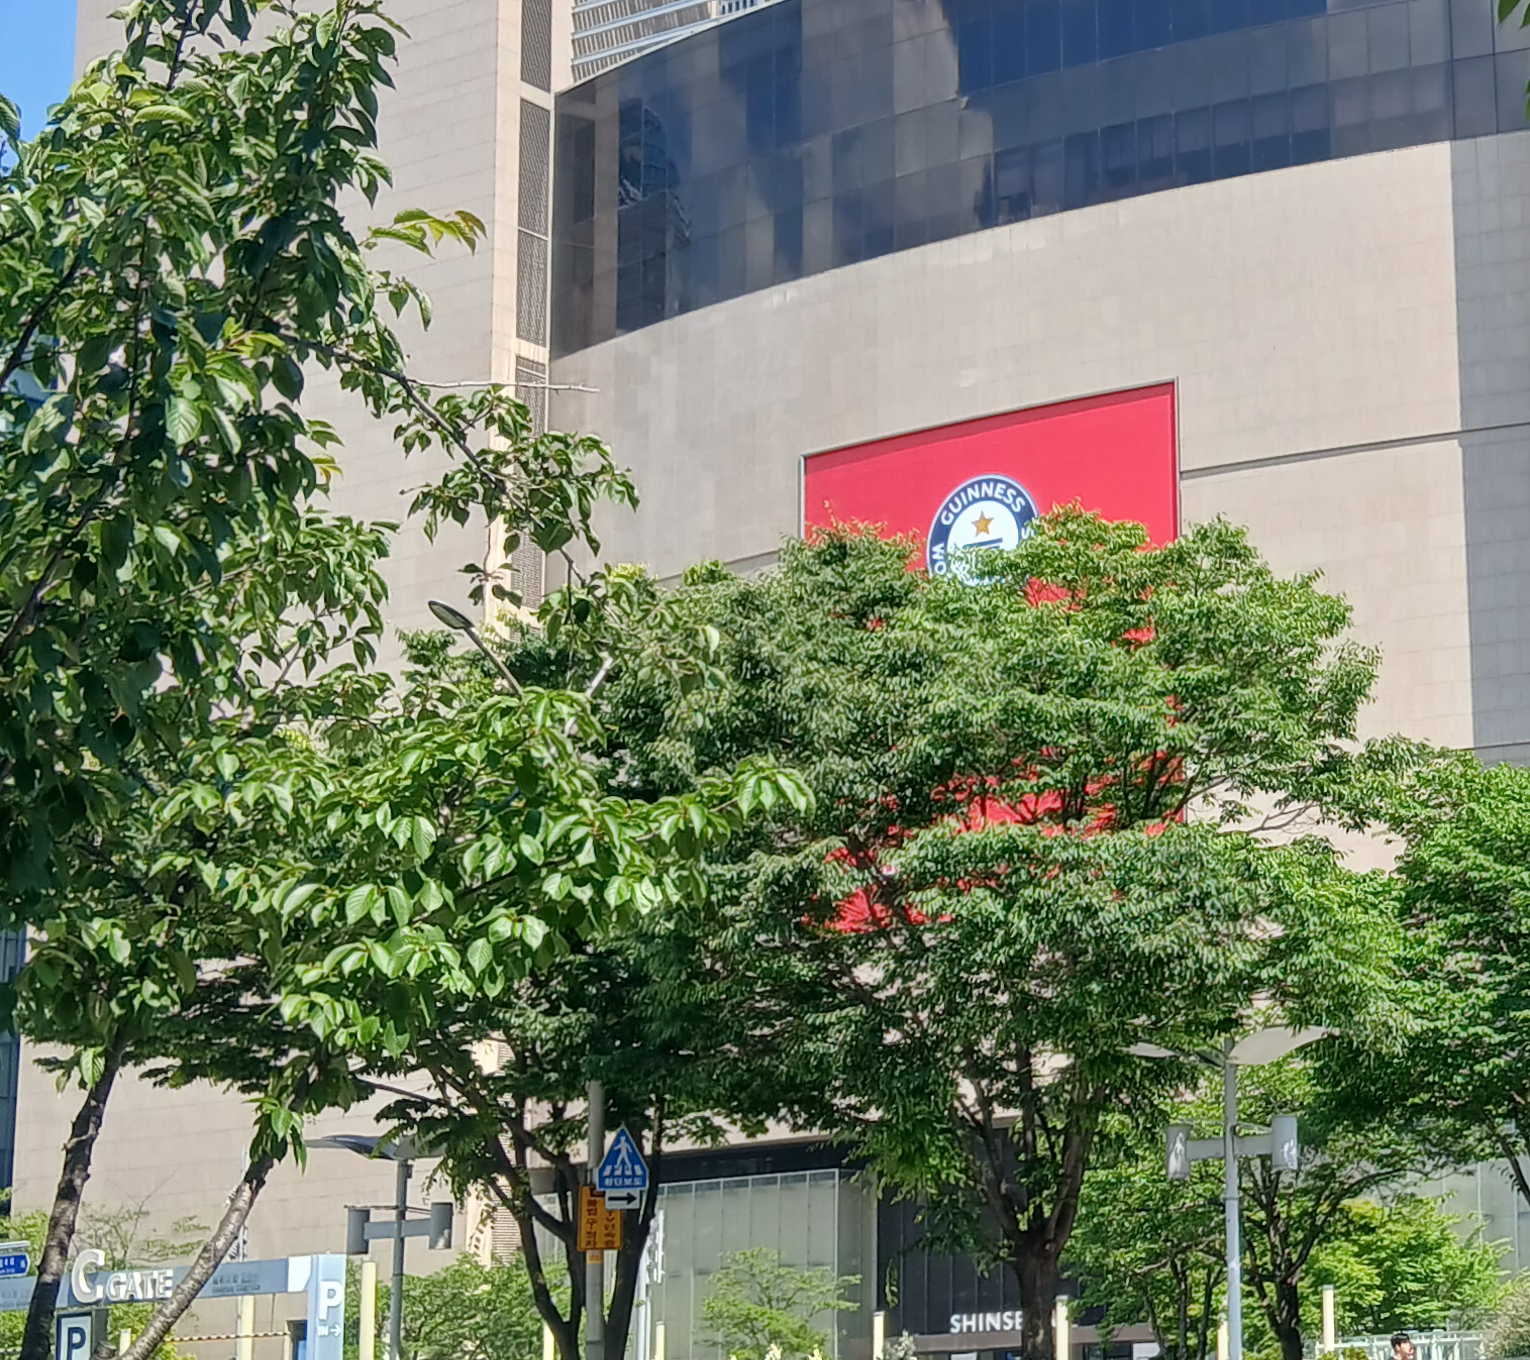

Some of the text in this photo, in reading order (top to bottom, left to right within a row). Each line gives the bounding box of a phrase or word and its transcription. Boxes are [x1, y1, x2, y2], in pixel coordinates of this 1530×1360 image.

[941, 482, 1025, 525] GUINNESS
[72, 1249, 105, 1303] C
[106, 1269, 173, 1301] GATE
[319, 1281, 343, 1320] P
